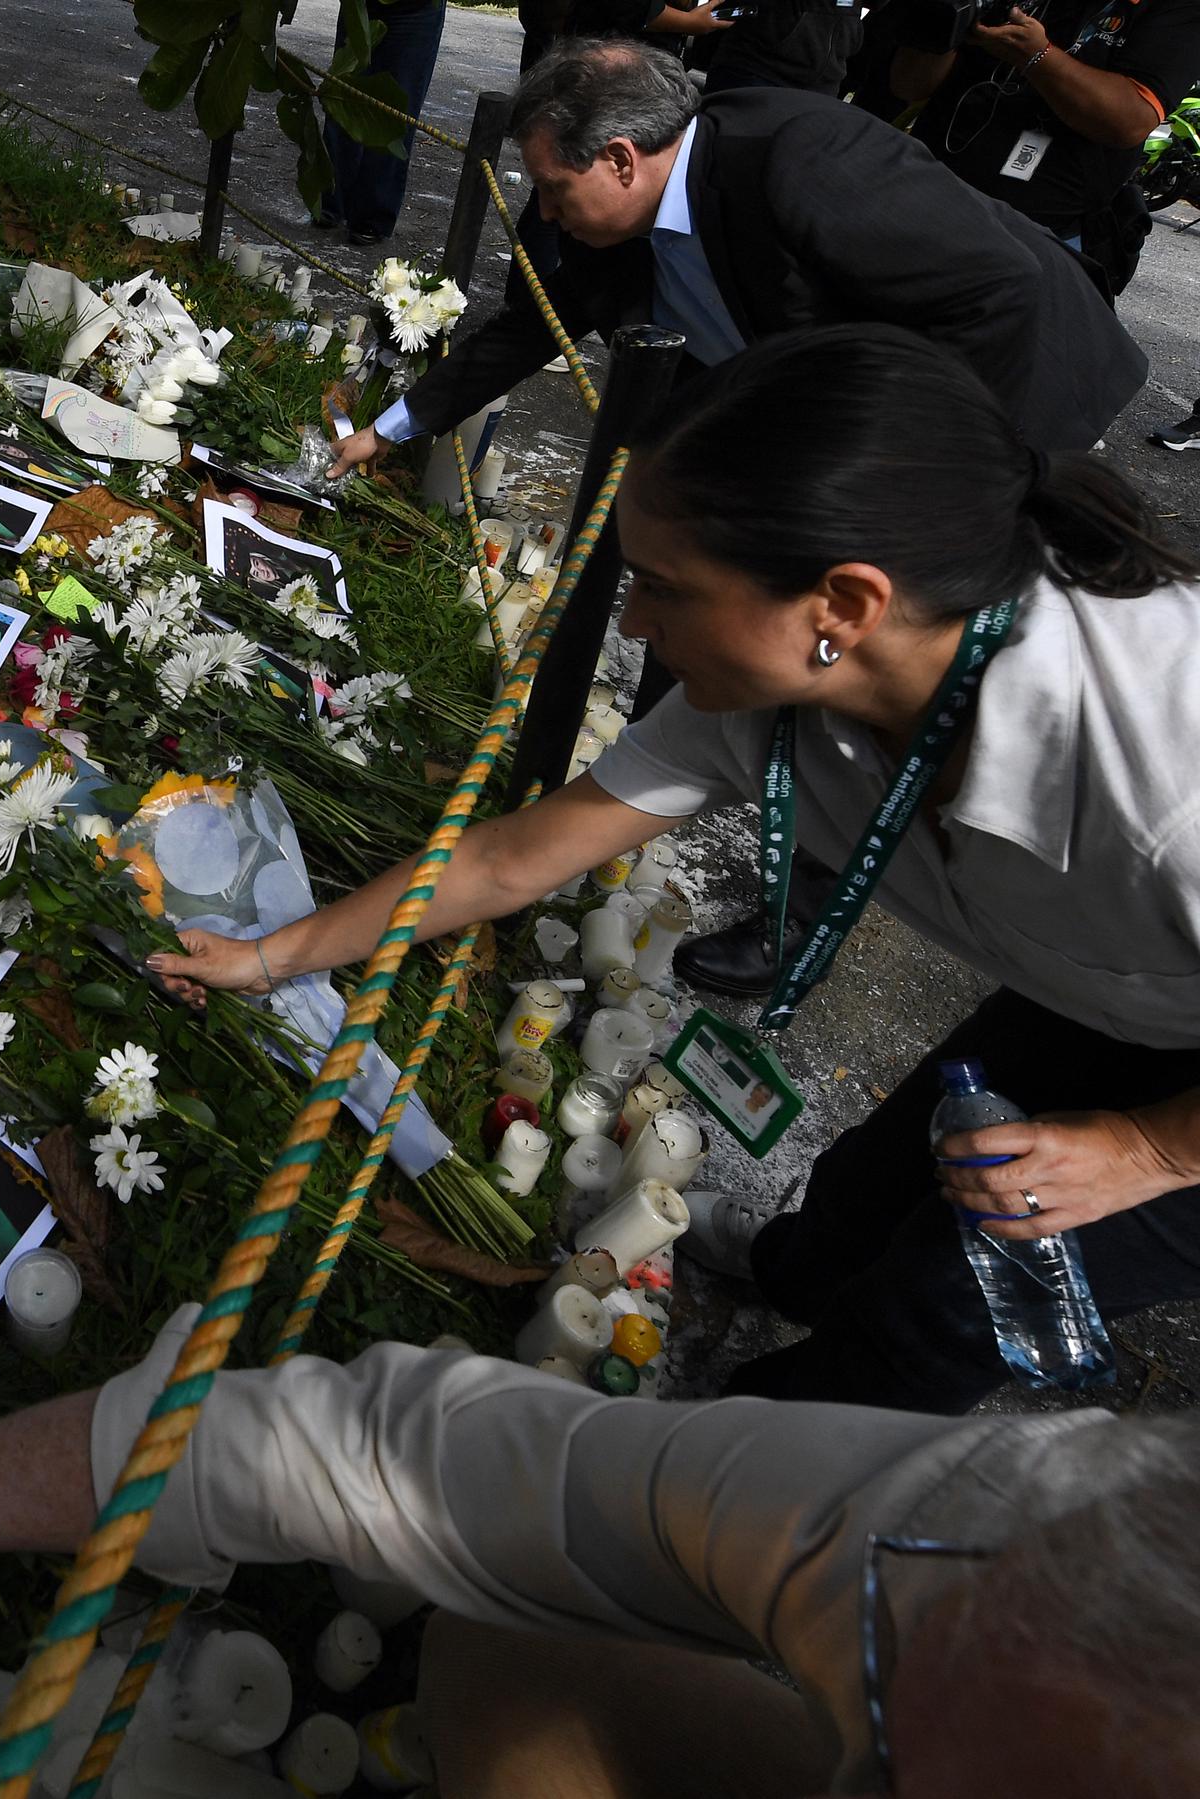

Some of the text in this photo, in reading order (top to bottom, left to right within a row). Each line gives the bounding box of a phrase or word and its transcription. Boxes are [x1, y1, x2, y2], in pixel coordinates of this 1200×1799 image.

[764, 741, 783, 798] Antioquia
[876, 756, 921, 828] de Antioquia
[890, 763, 936, 833] Gobernación
[789, 924, 830, 982] de Antioquia
[800, 930, 843, 985] Gobernación
